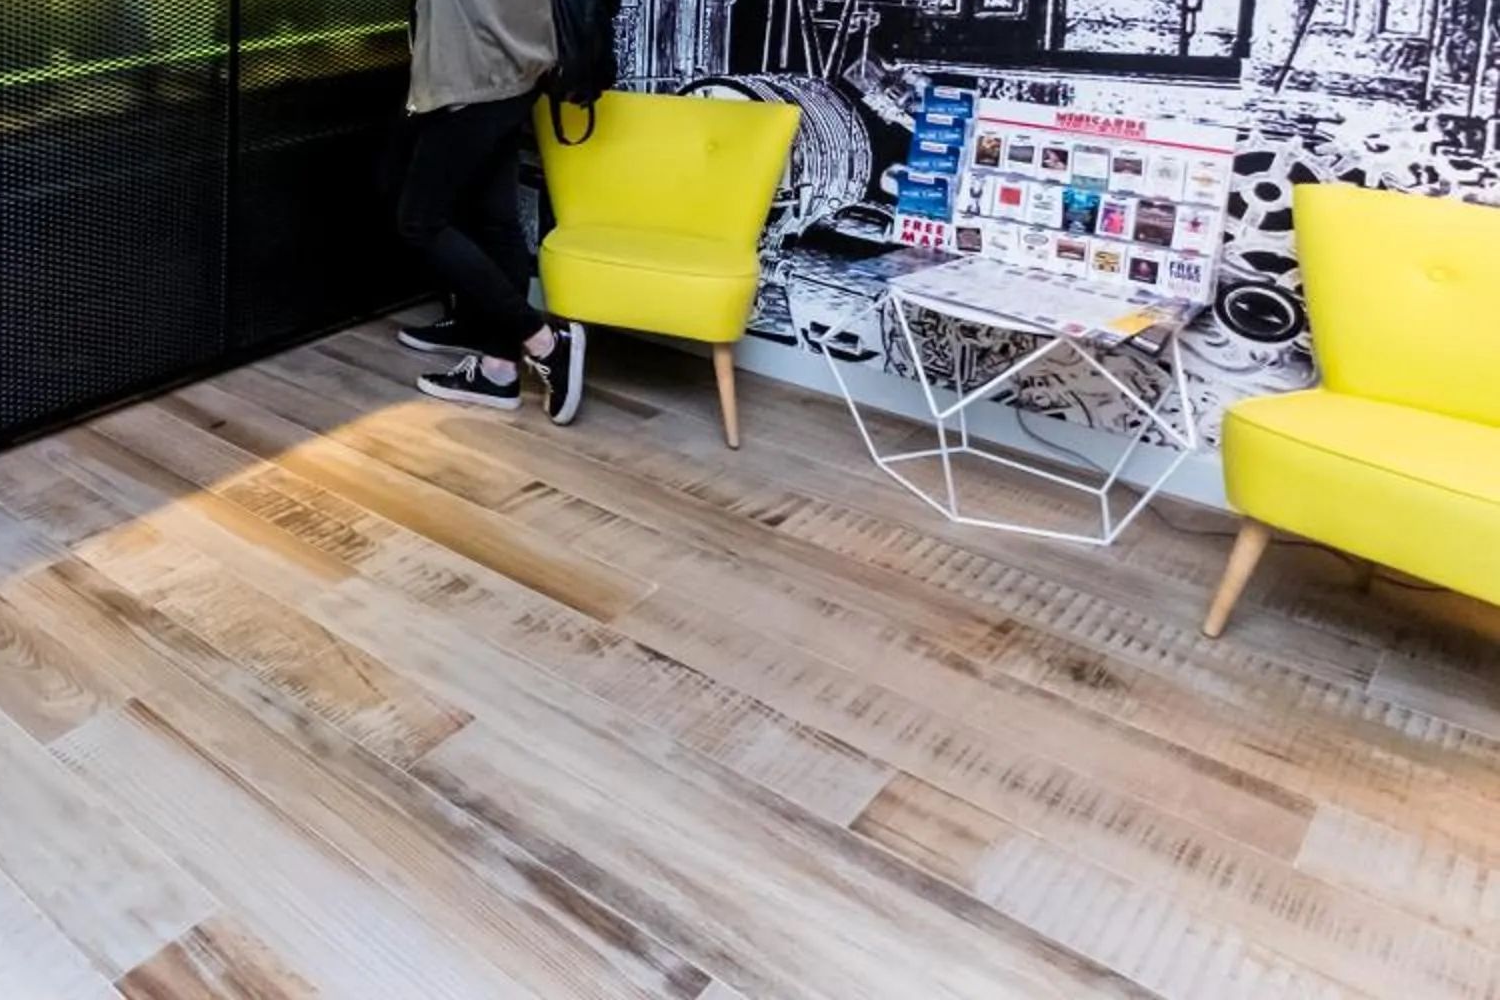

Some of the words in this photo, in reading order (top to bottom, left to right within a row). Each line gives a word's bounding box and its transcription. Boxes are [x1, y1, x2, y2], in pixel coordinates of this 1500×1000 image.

[902, 218, 945, 236] FREE
[900, 231, 944, 248] MAP
[1169, 260, 1202, 275] FREE
